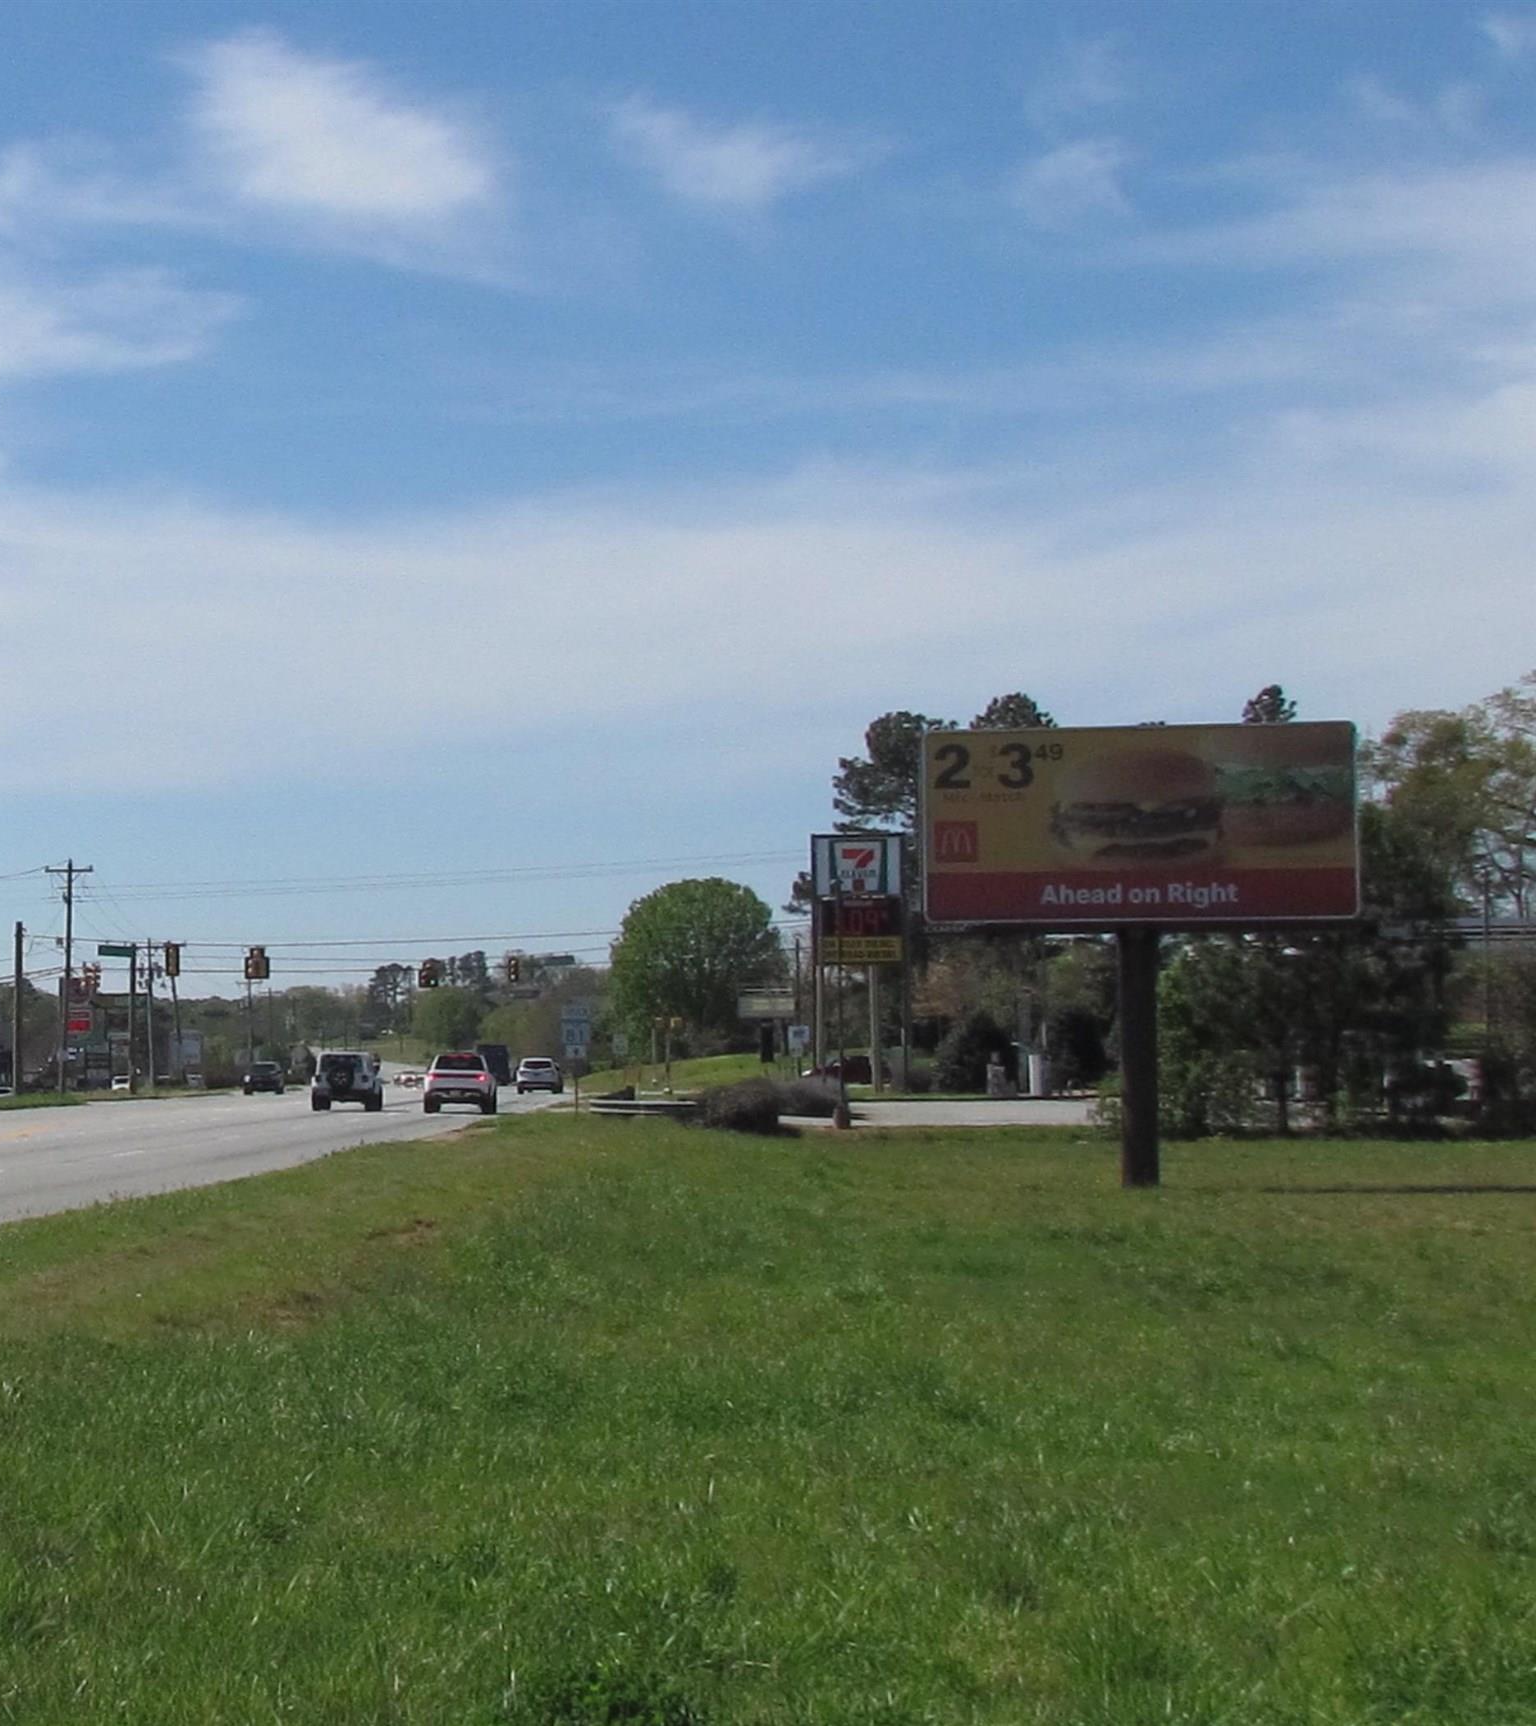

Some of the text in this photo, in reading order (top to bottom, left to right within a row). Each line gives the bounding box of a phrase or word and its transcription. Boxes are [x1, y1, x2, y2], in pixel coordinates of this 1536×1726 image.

[934, 743, 971, 789] 2
[841, 848, 875, 869] 7
[1040, 882, 1239, 908] Ahead on Right
